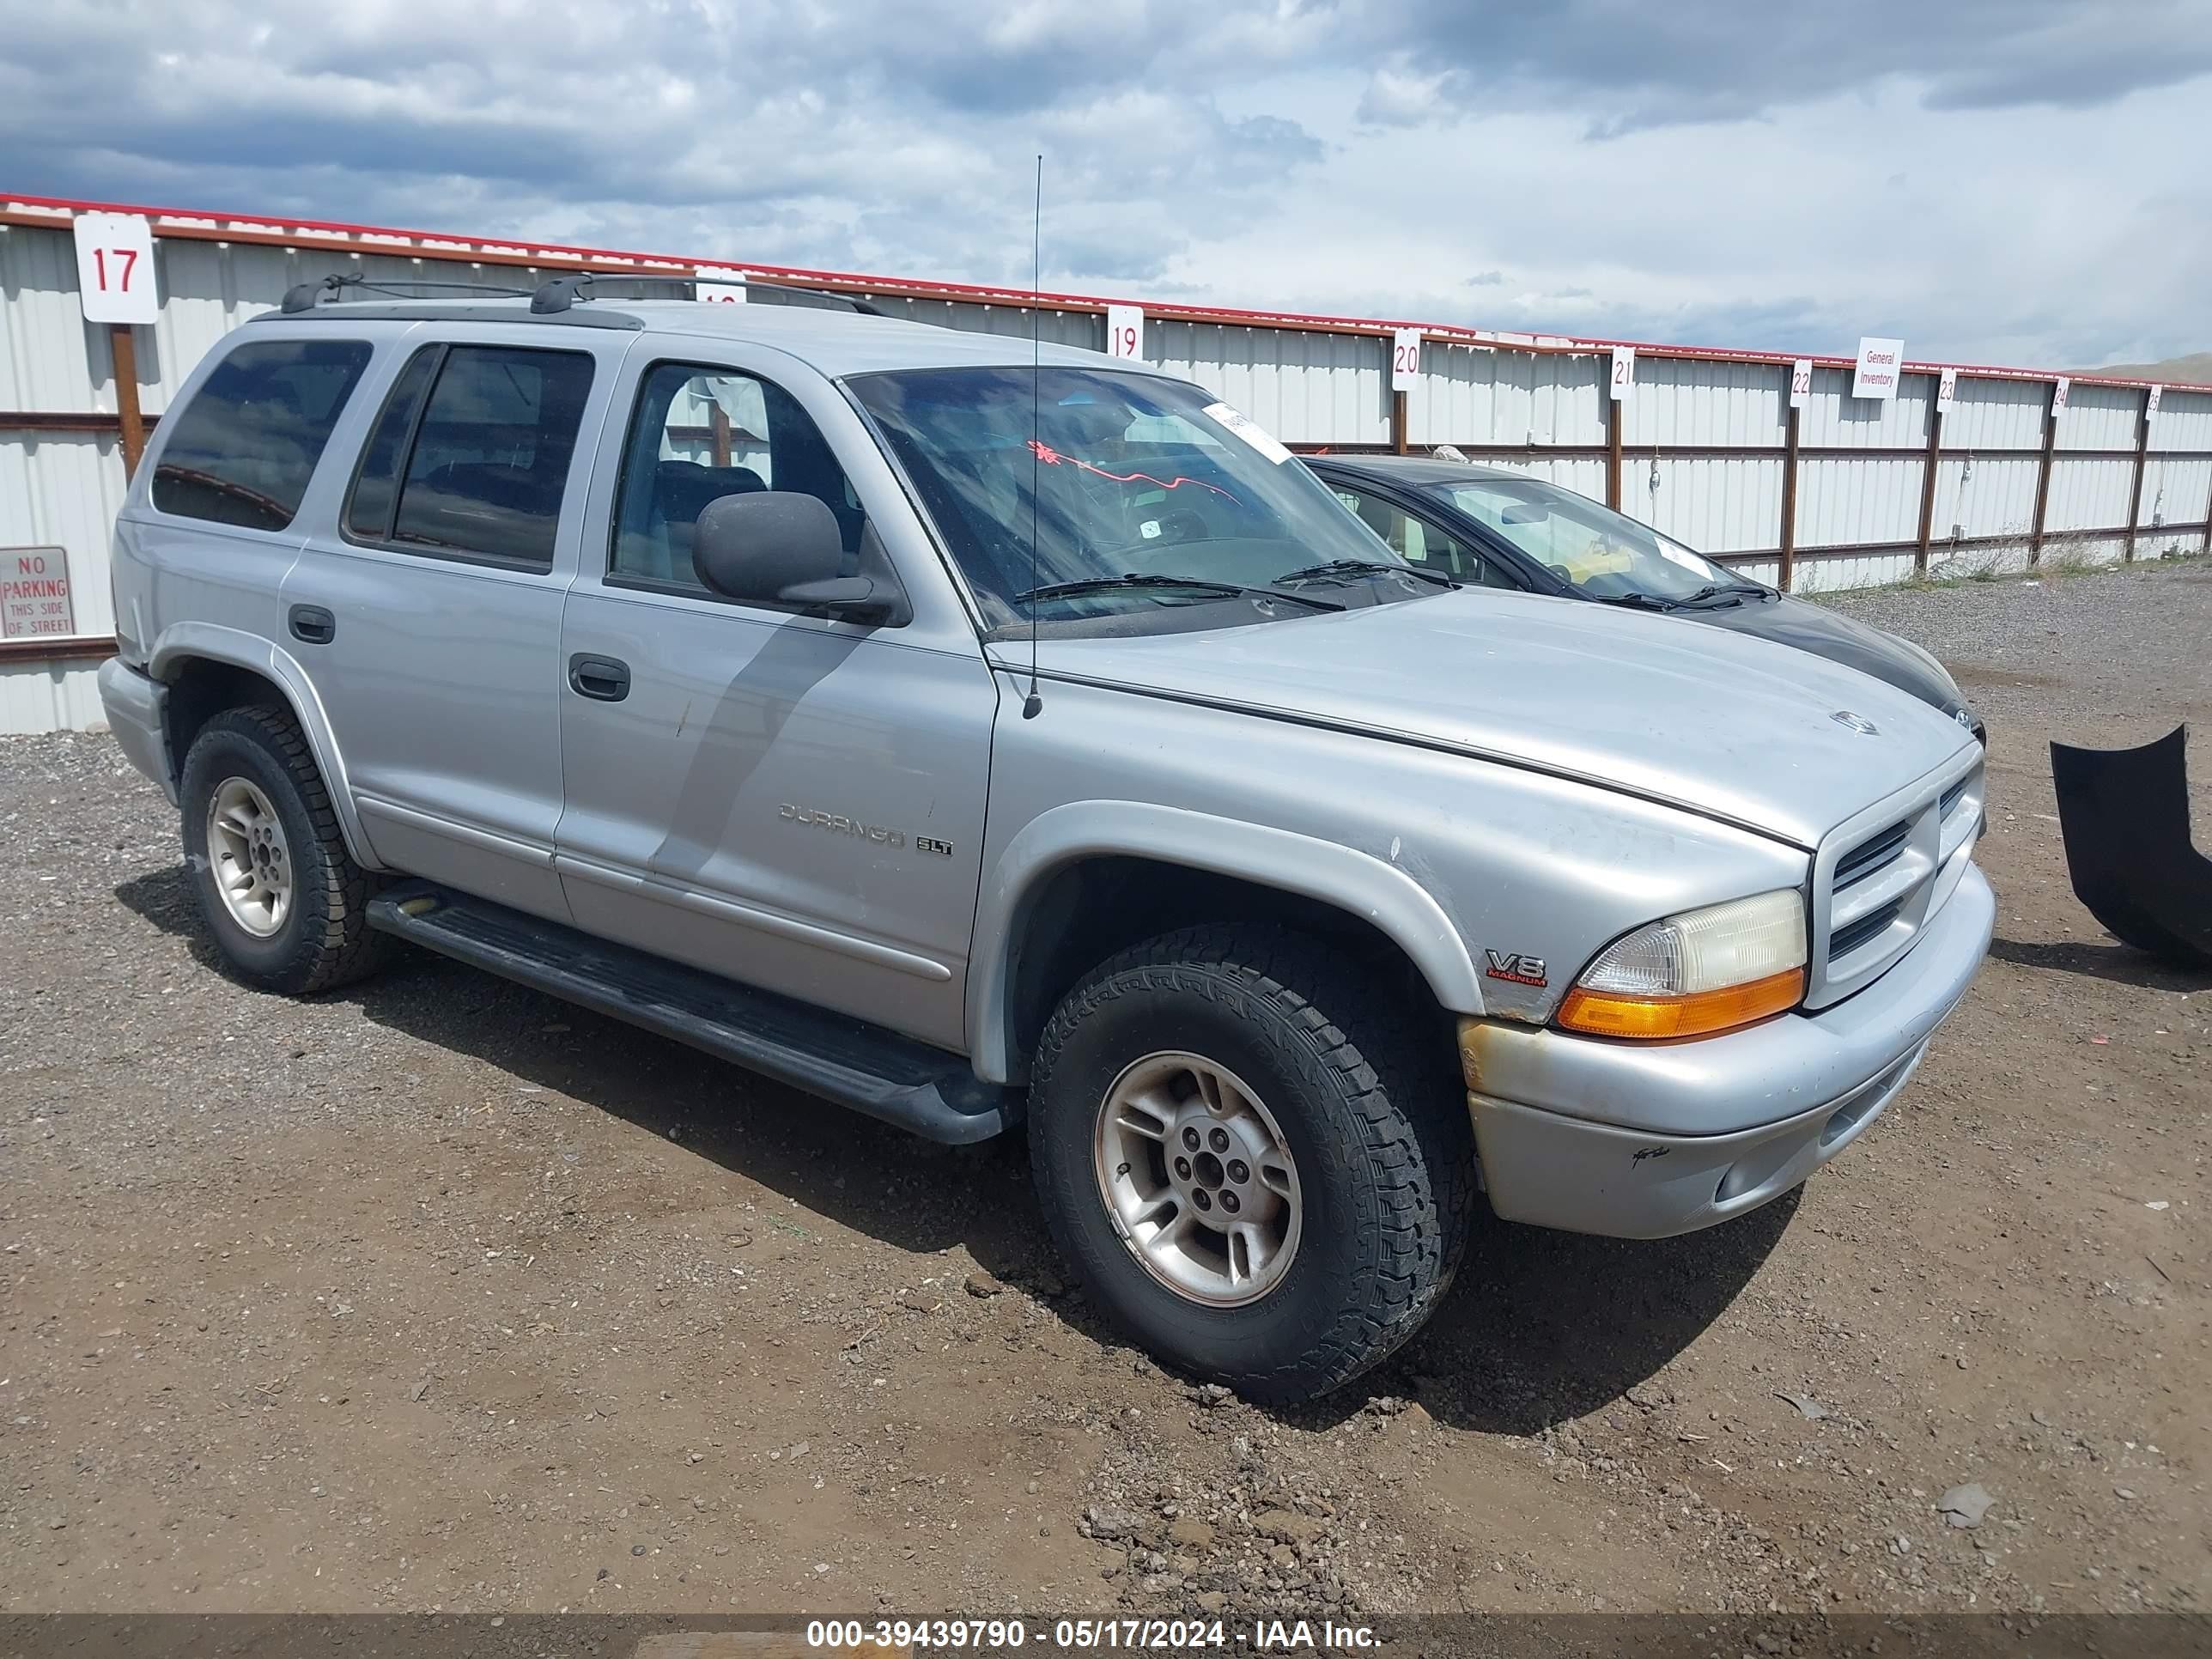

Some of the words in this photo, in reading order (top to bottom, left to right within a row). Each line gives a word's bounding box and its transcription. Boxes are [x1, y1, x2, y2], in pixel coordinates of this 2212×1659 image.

[94, 247, 137, 292] 17
[1115, 326, 1136, 356] 19
[1395, 345, 1417, 373] 20
[1867, 350, 1895, 365] General
[1615, 361, 1630, 385] 21
[1793, 372, 1809, 393] 22
[1860, 370, 1894, 388] Inventory
[1941, 380, 1953, 400] 23
[2055, 387, 2066, 405] 24
[18, 556, 46, 574] NO
[3, 579, 66, 599] PARKING
[10, 603, 33, 617] THIS
[40, 601, 64, 615] SIDE
[8, 623, 22, 635] OF
[30, 619, 69, 633] STREET
[779, 803, 906, 847] DURANGO
[917, 838, 952, 855] SLT
[1486, 948, 1546, 979] V8
[1487, 969, 1547, 987] MAGNUM
